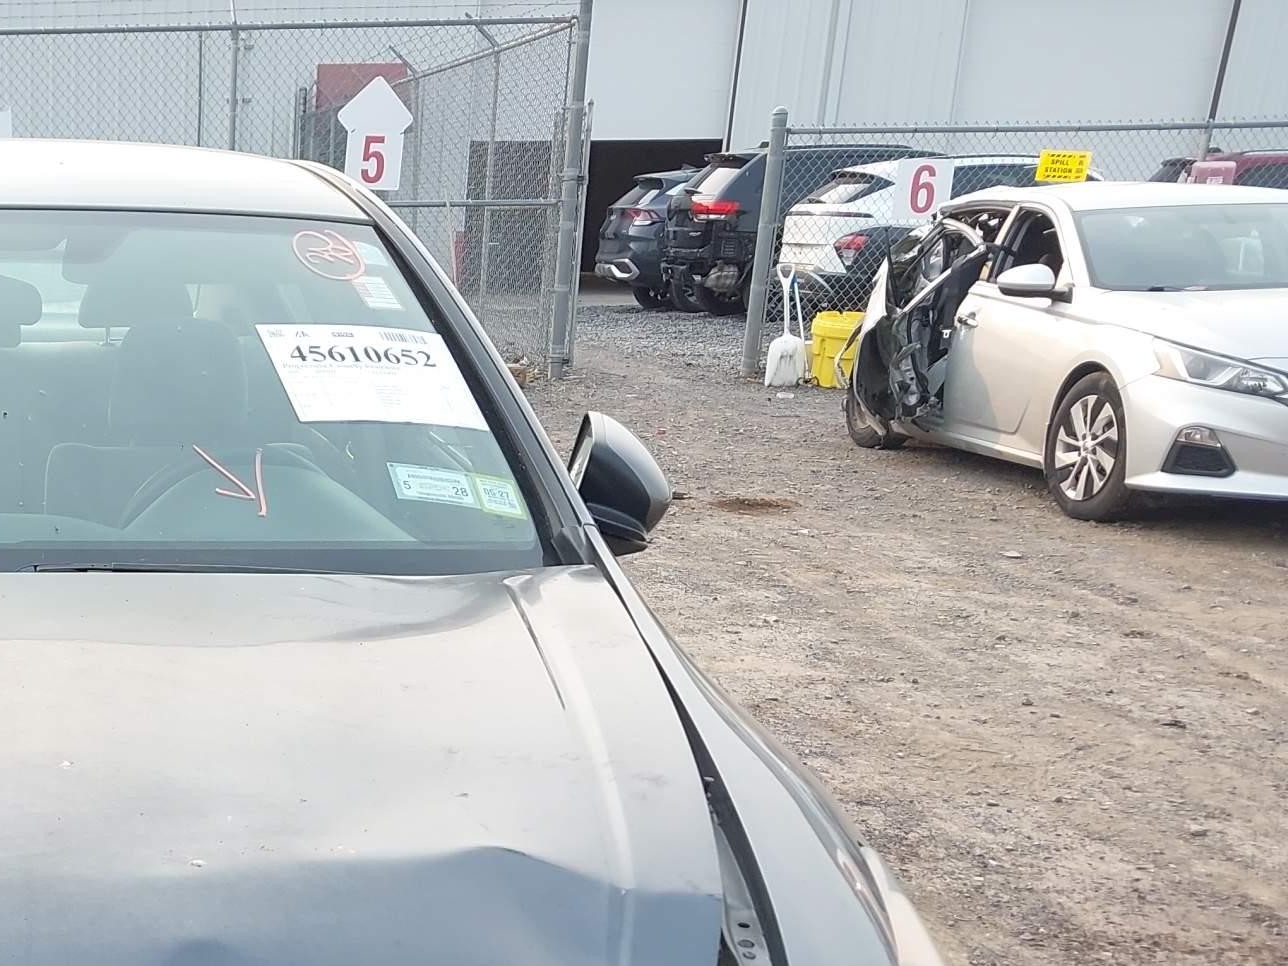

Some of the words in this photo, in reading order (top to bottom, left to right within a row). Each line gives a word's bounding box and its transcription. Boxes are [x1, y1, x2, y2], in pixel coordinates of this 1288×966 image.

[361, 135, 386, 184] 5
[1044, 166, 1073, 174] STATION
[910, 164, 937, 214] 6
[290, 344, 437, 368] 45610652
[403, 480, 412, 490] 5
[452, 486, 469, 497] 28
